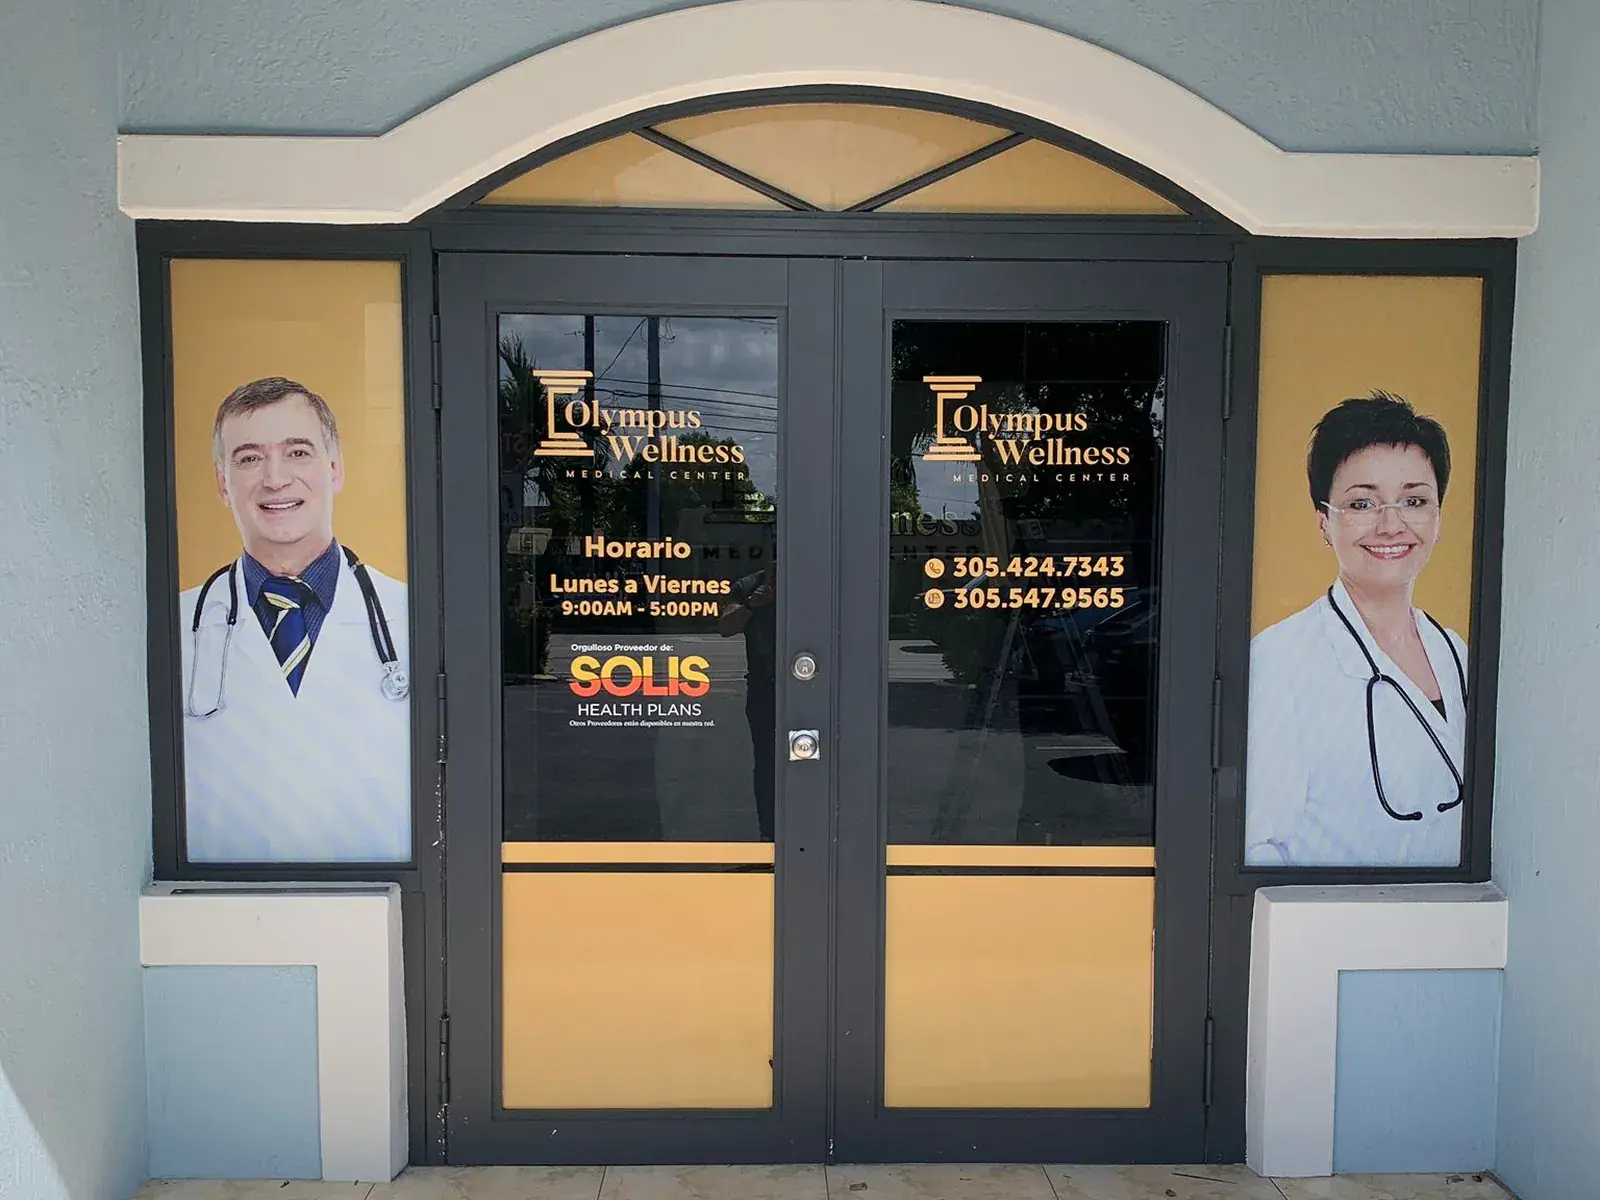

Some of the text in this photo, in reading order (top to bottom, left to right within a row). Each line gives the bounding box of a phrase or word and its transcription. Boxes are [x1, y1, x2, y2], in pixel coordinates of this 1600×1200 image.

[564, 399, 702, 437] Olympus
[953, 404, 1088, 440] Olympus
[605, 434, 745, 464] Wellness
[993, 438, 1131, 466] Wellness
[566, 470, 745, 480] MEDICAL CENTER
[953, 473, 1130, 483] MEDICAL CENTER
[585, 536, 692, 560] Horario
[953, 556, 1125, 577] 305.424.7343
[550, 574, 731, 595] Lunes a Viernes
[562, 600, 633, 616] 9:00AM
[650, 601, 719, 617] 5:00PM
[953, 587, 1125, 609] 305.547.9565
[571, 643, 674, 653] Orgulloso Proveedor de:
[569, 655, 711, 698] SOLIS
[577, 703, 702, 717] HEALTH PLANS
[569, 719, 587, 727] Otros
[587, 719, 623, 727] Proveedores
[640, 719, 673, 729] disponibles
